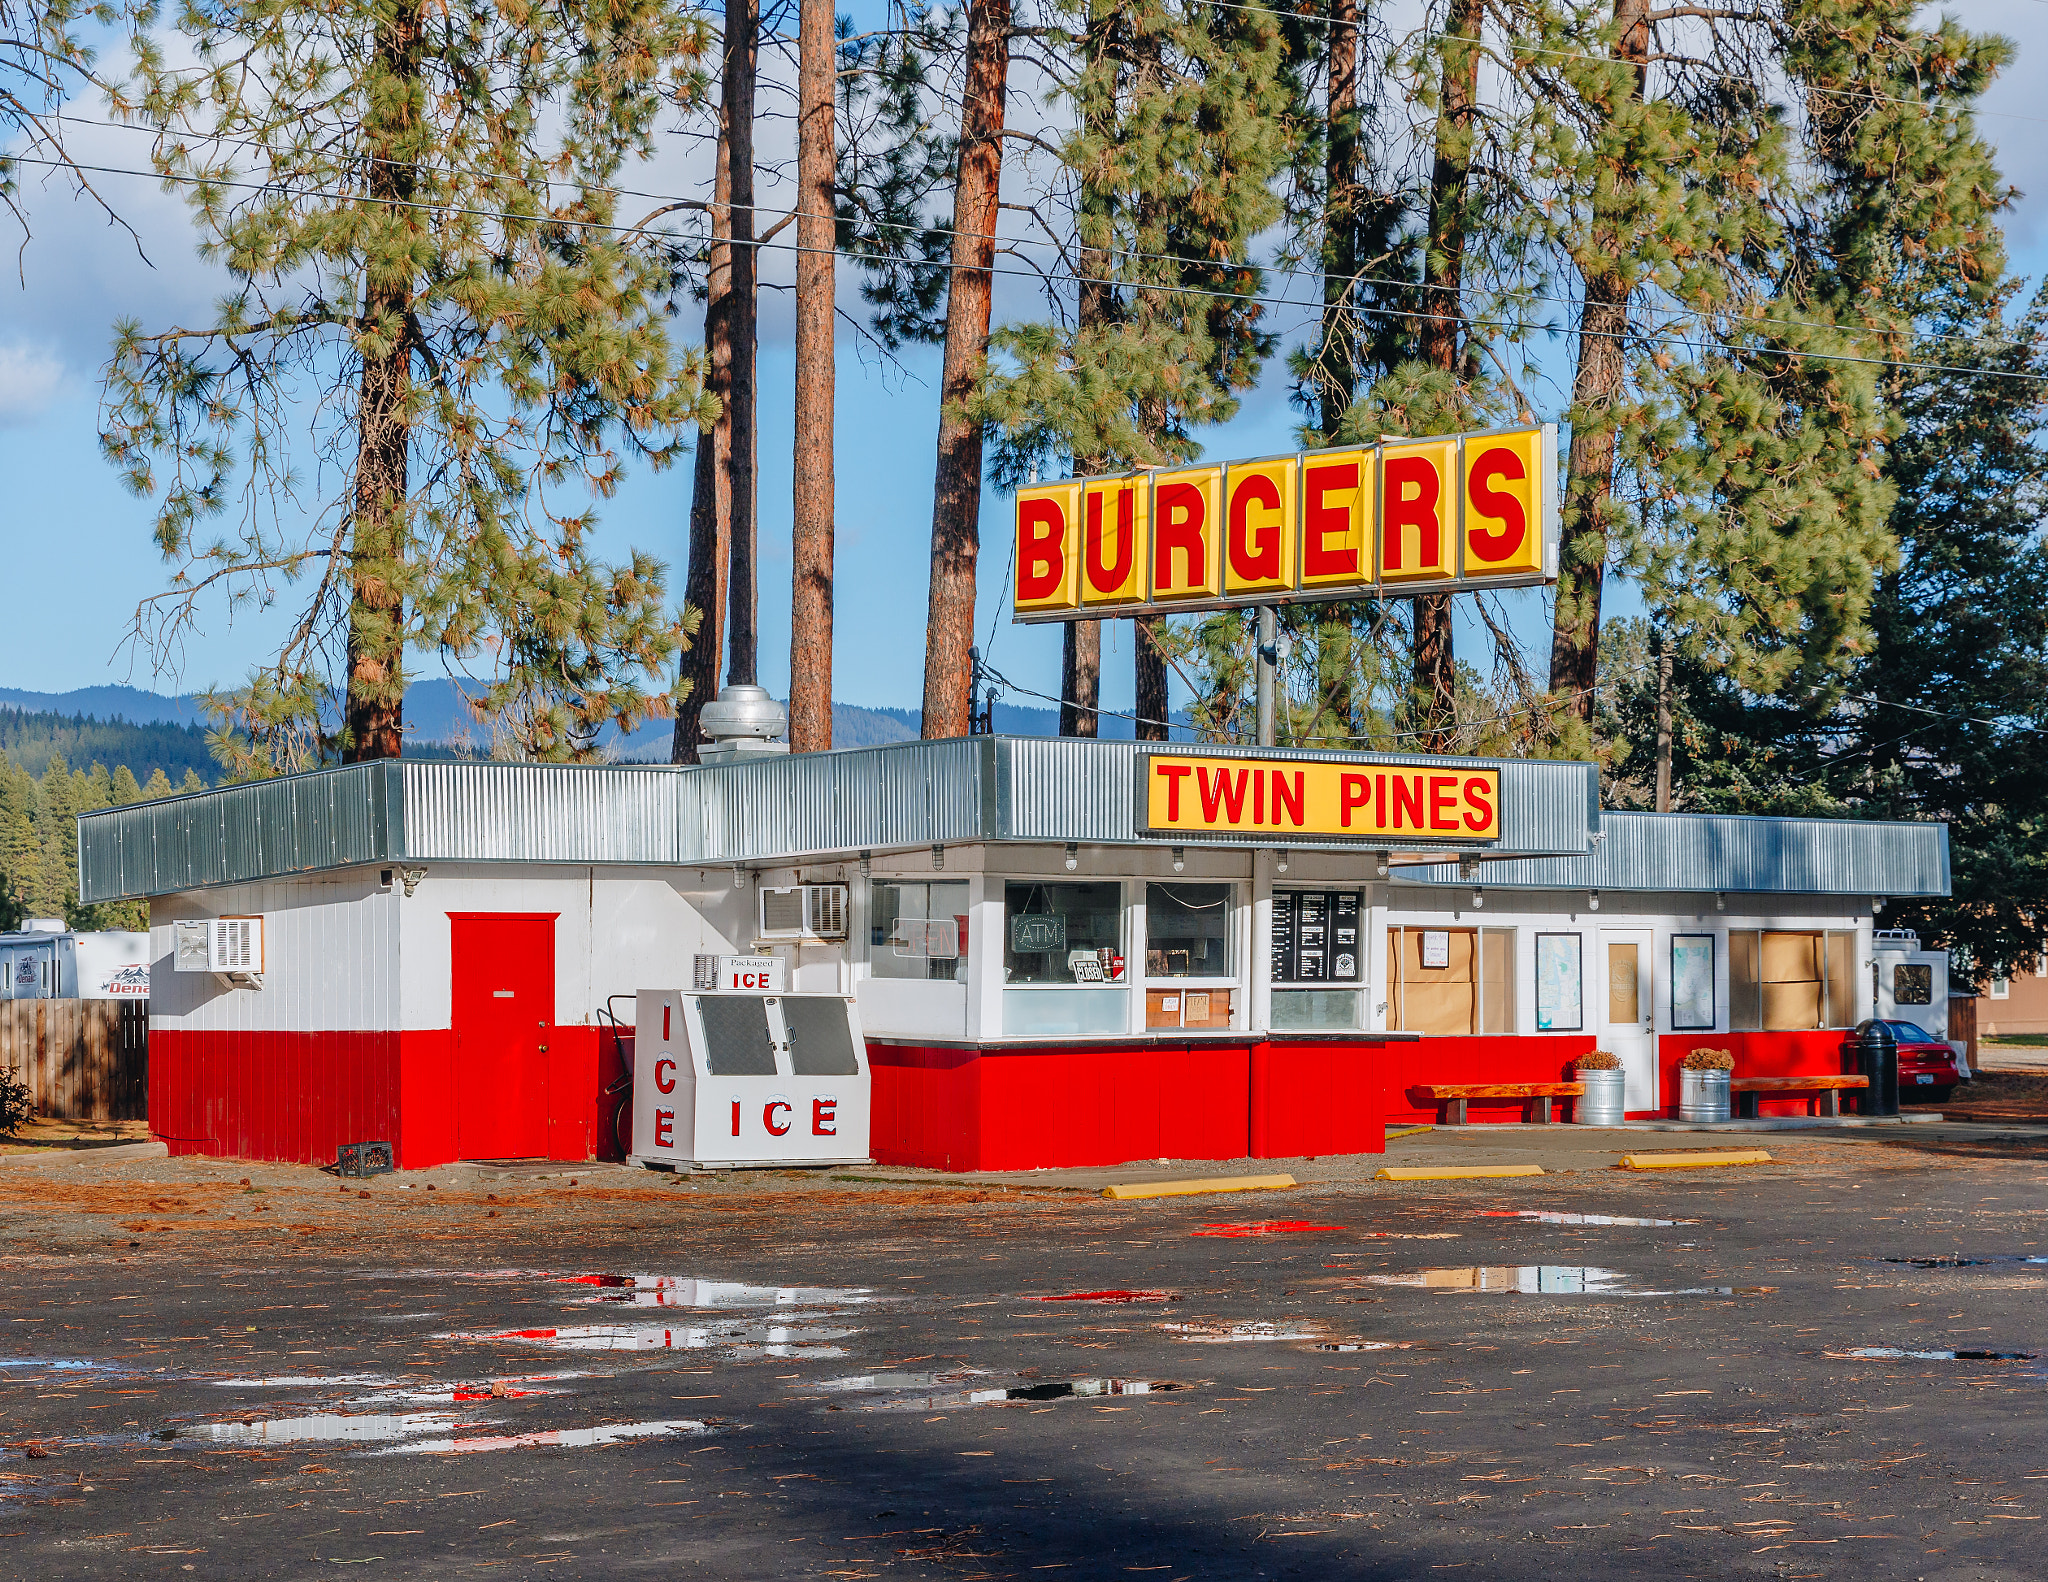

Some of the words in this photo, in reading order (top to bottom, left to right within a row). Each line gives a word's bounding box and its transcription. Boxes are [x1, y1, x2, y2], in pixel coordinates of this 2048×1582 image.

[1018, 447, 1526, 601] BURGERS
[1156, 764, 1305, 827] TWIN
[1340, 772, 1493, 832] PINES
[896, 923, 954, 955] OPEN
[1020, 923, 1058, 943] ATM
[731, 959, 773, 968] Packaged
[1077, 967, 1102, 980] CLOSED
[733, 971, 770, 989] ICE
[655, 998, 677, 1148] ICE
[730, 1093, 838, 1137] ICE
